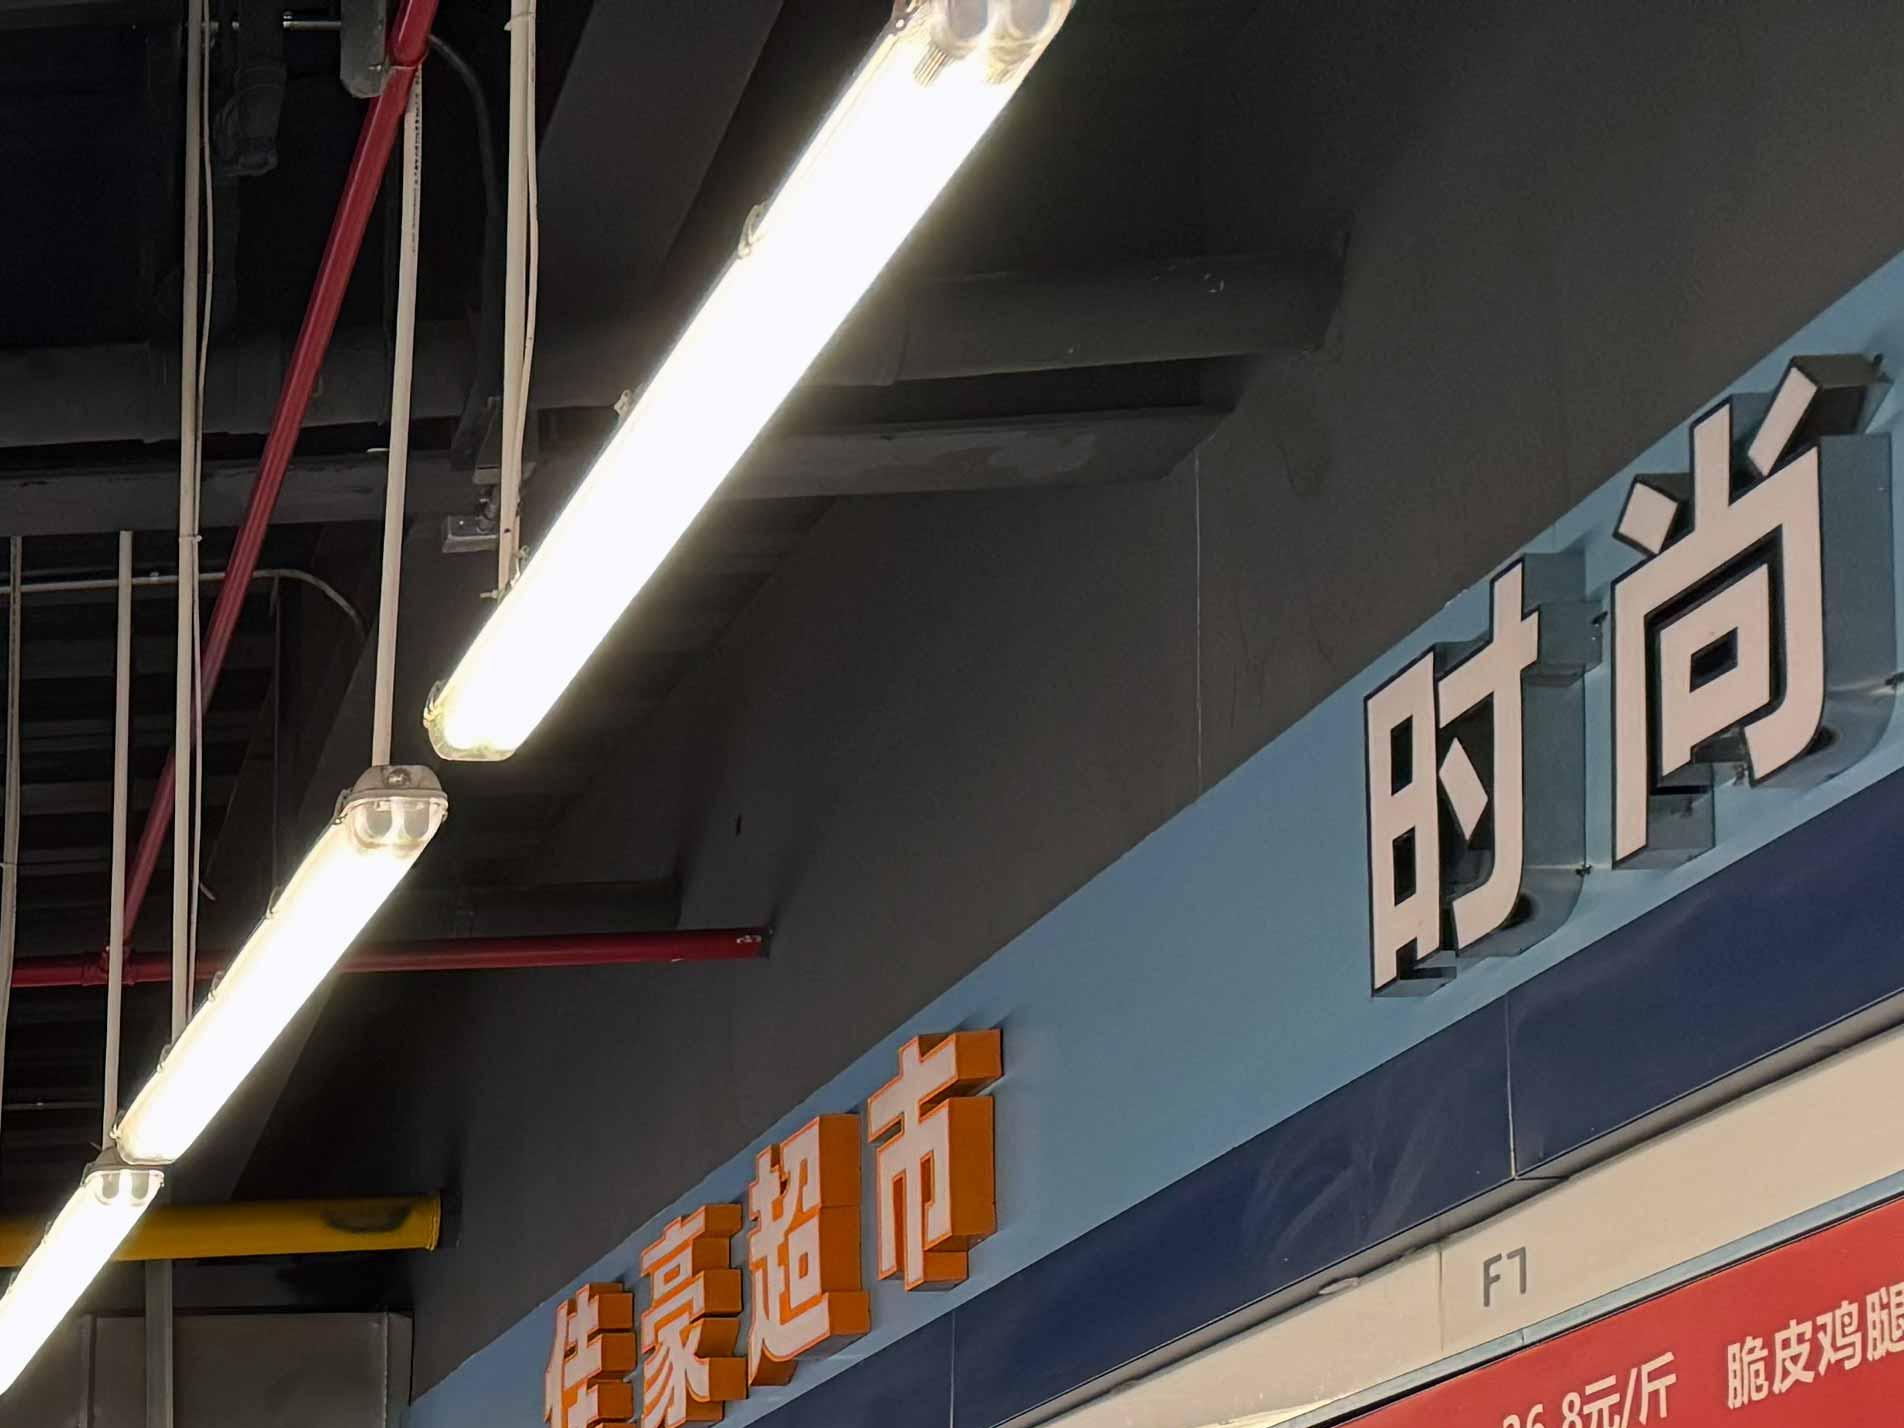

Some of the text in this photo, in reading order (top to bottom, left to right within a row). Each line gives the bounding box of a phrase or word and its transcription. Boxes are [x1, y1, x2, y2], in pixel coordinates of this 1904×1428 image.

[1363, 366, 1826, 992] 时尚
[1726, 1284, 1904, 1410] 脆皮鸡腿
